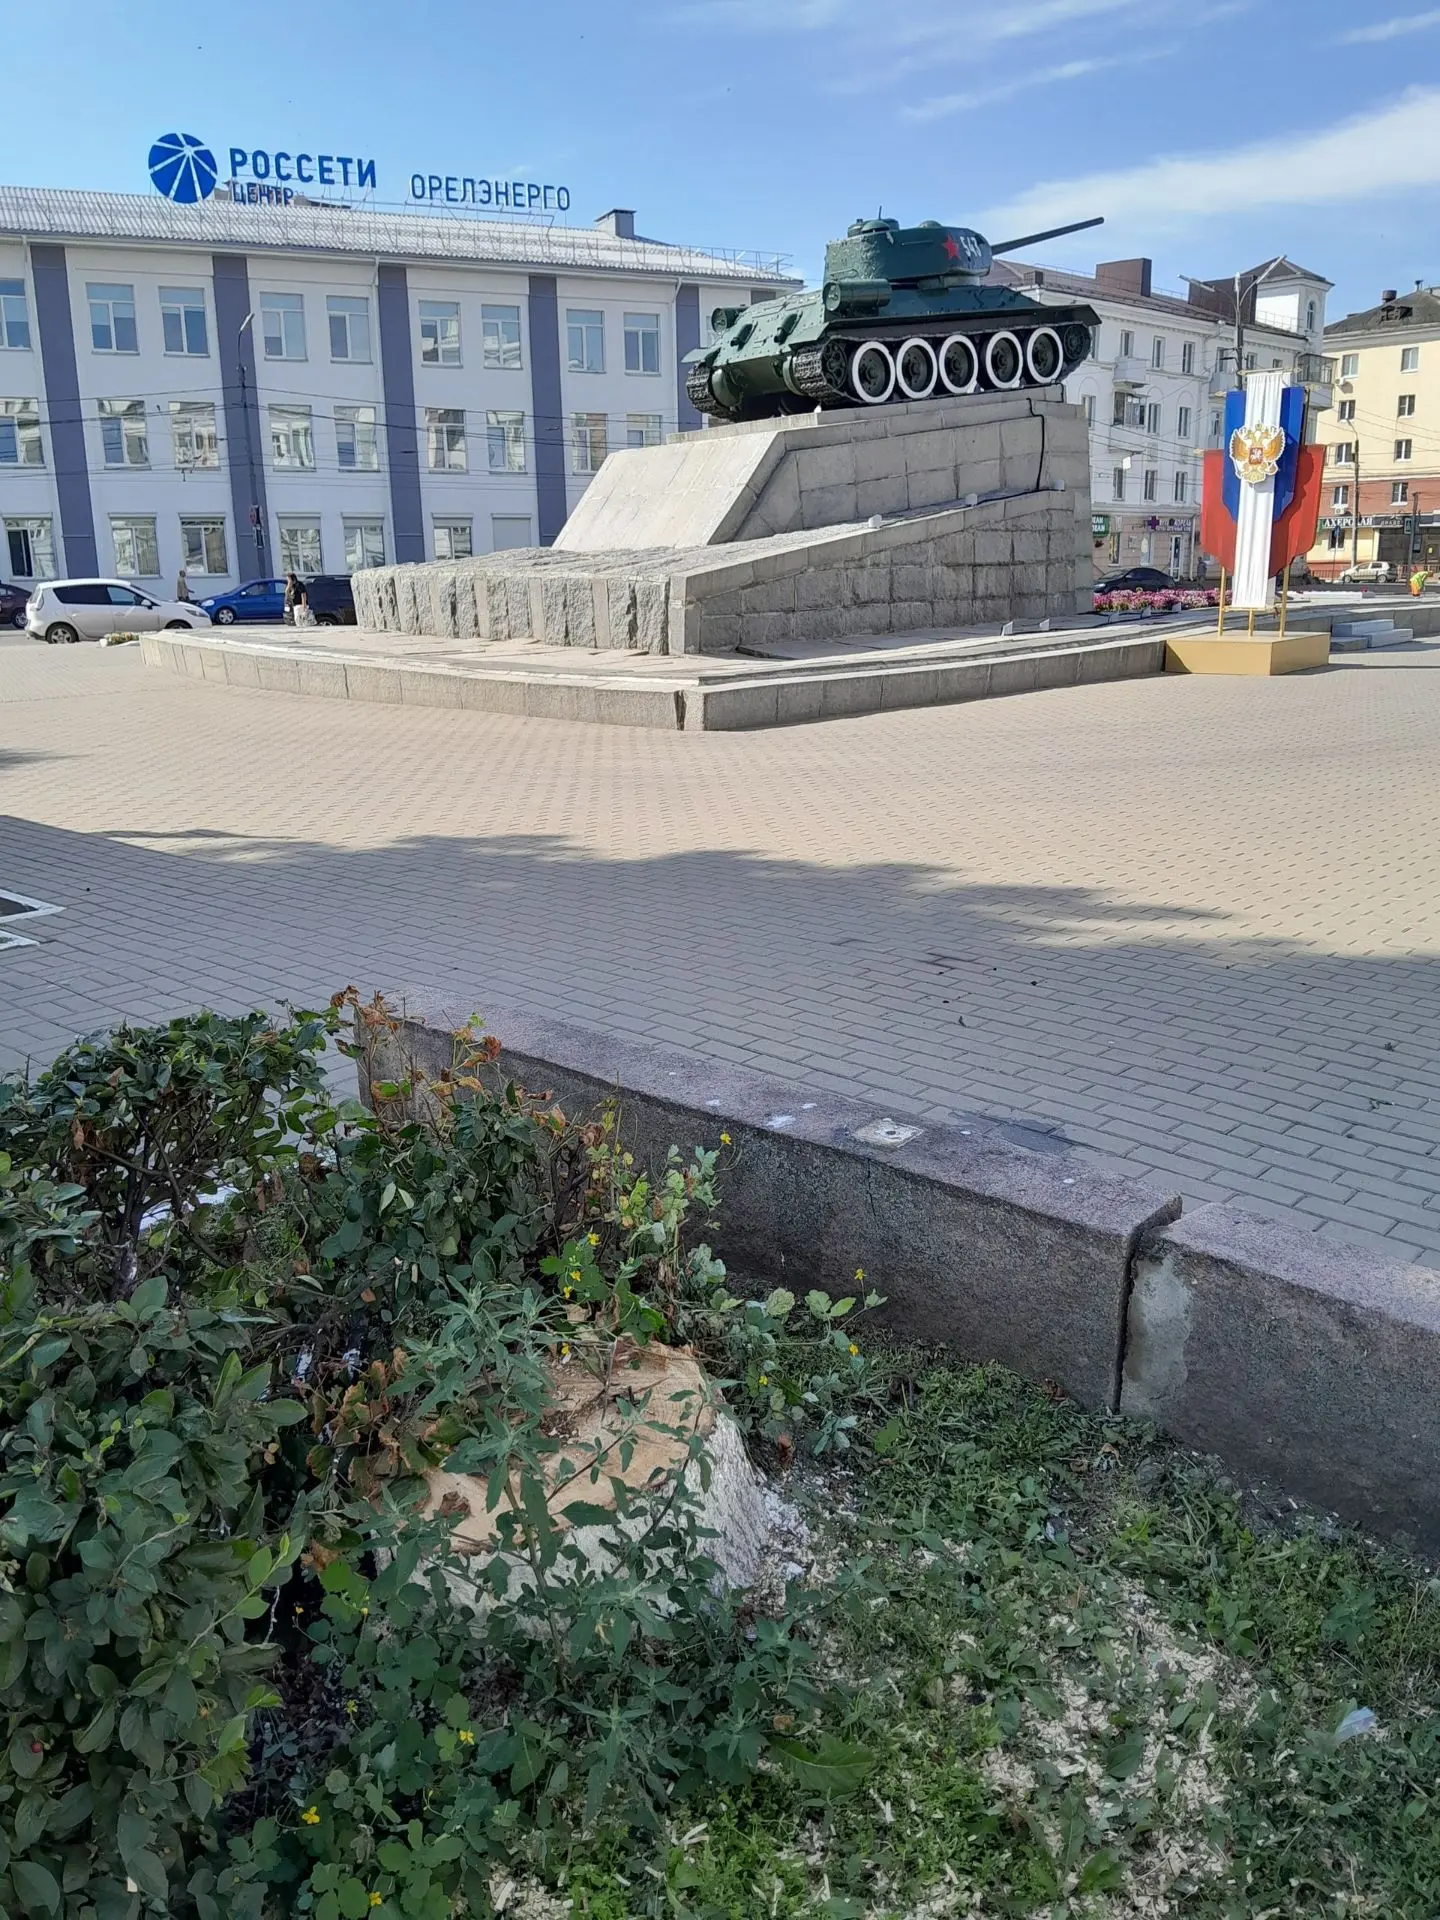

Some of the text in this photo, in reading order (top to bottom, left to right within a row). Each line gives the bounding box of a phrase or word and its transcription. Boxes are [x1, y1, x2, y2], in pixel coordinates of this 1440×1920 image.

[229, 147, 377, 189] РОССЕТИ
[232, 182, 294, 205] ЦЕНТР
[411, 173, 571, 211] ОРЕЛЭНЕРГО
